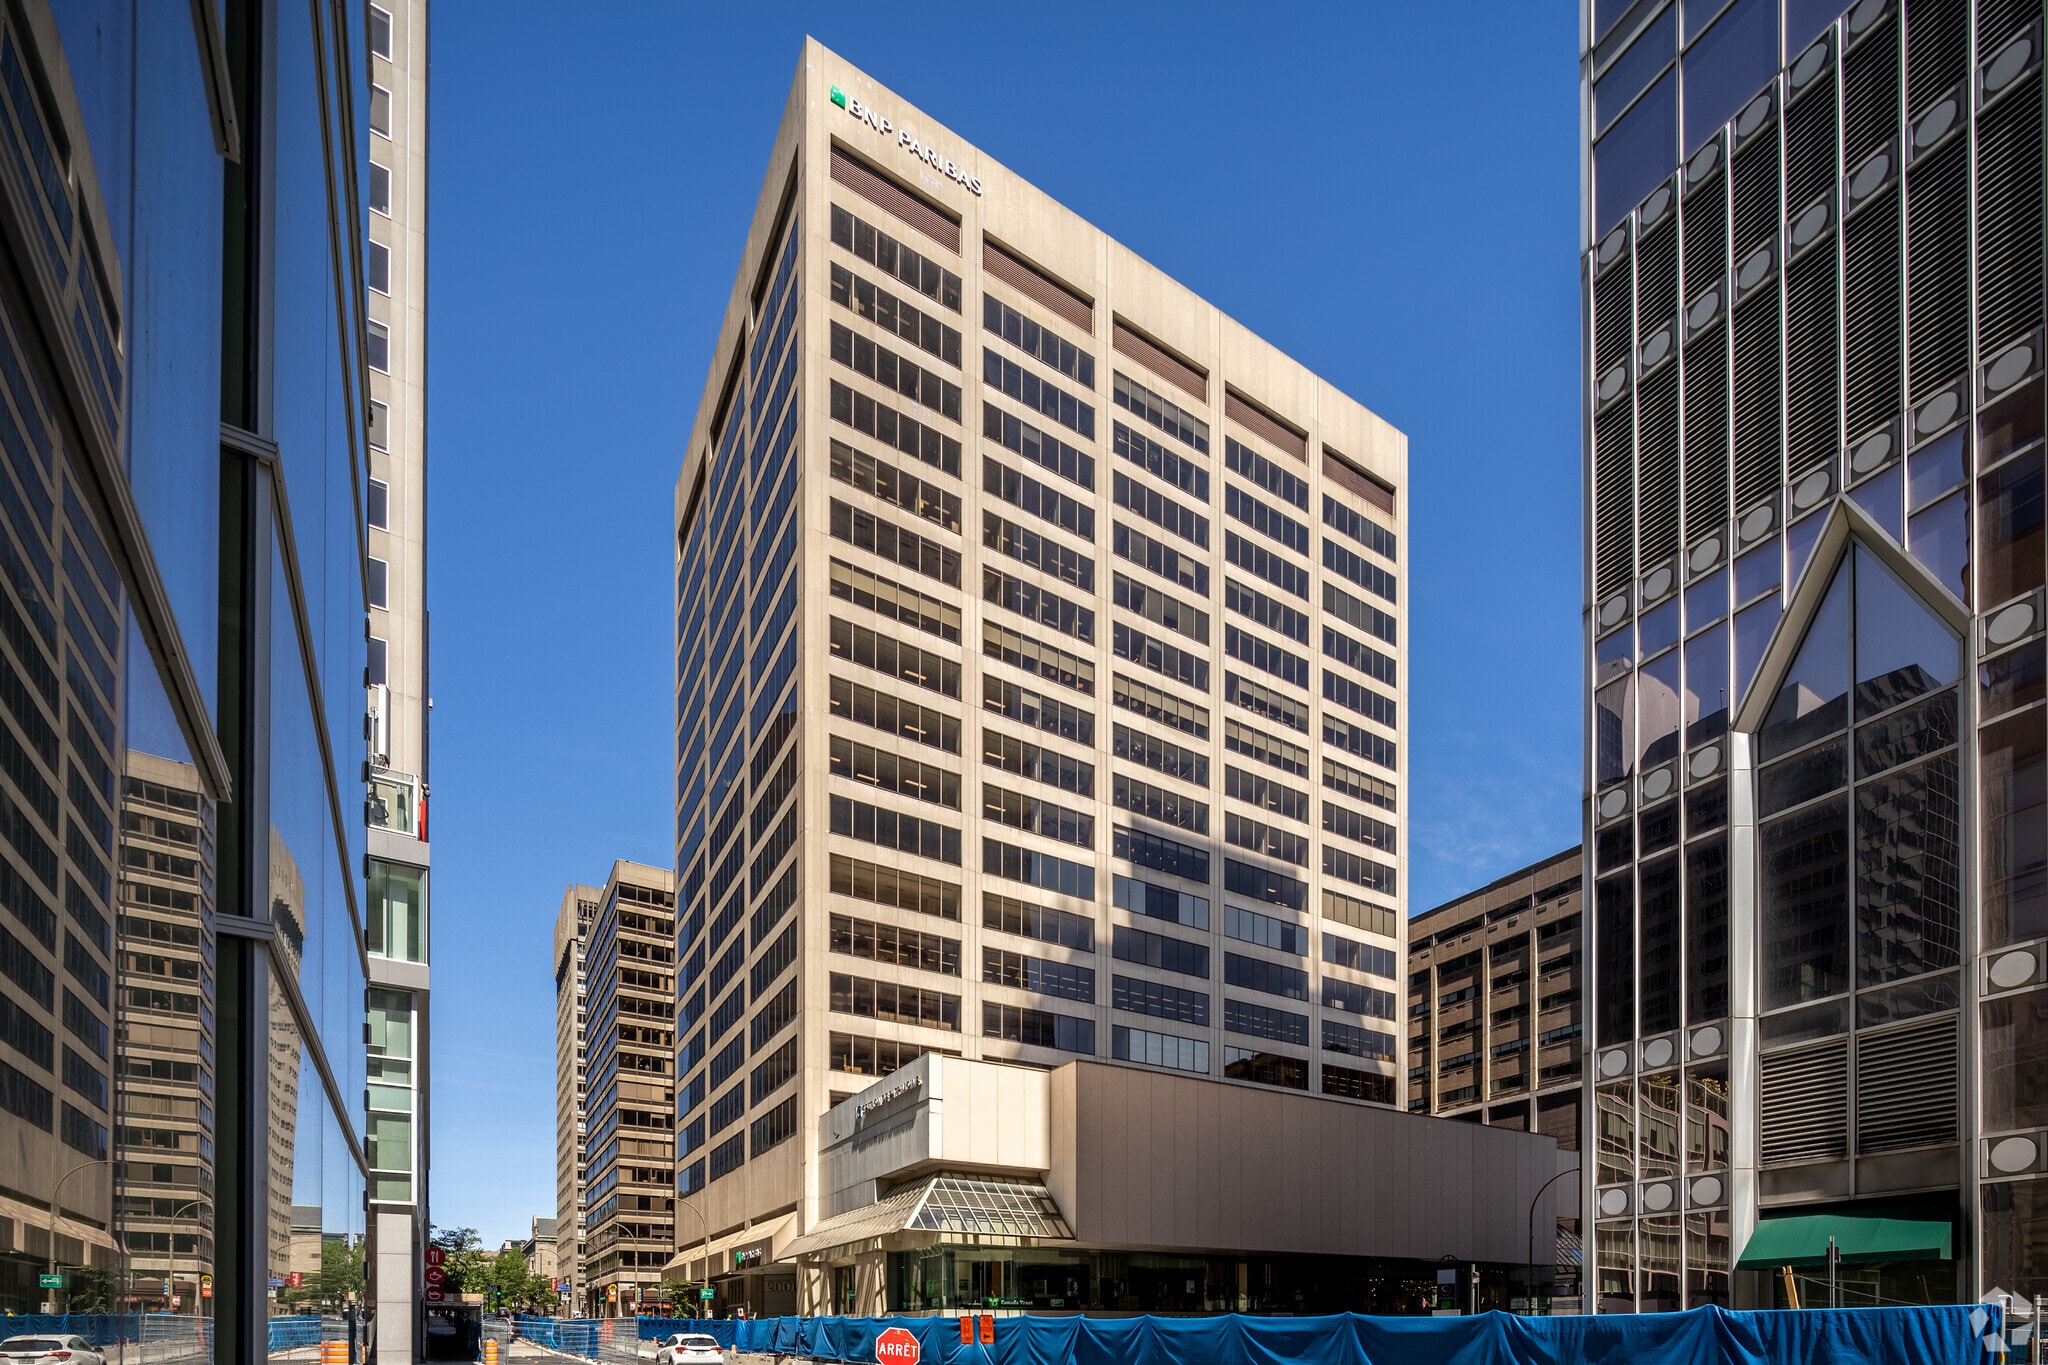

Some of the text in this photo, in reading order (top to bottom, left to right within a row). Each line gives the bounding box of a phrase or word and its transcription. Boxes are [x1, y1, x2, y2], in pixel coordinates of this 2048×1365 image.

[849, 96, 982, 197] BNP PARIBAS
[878, 1342, 917, 1358] ARRÊT
